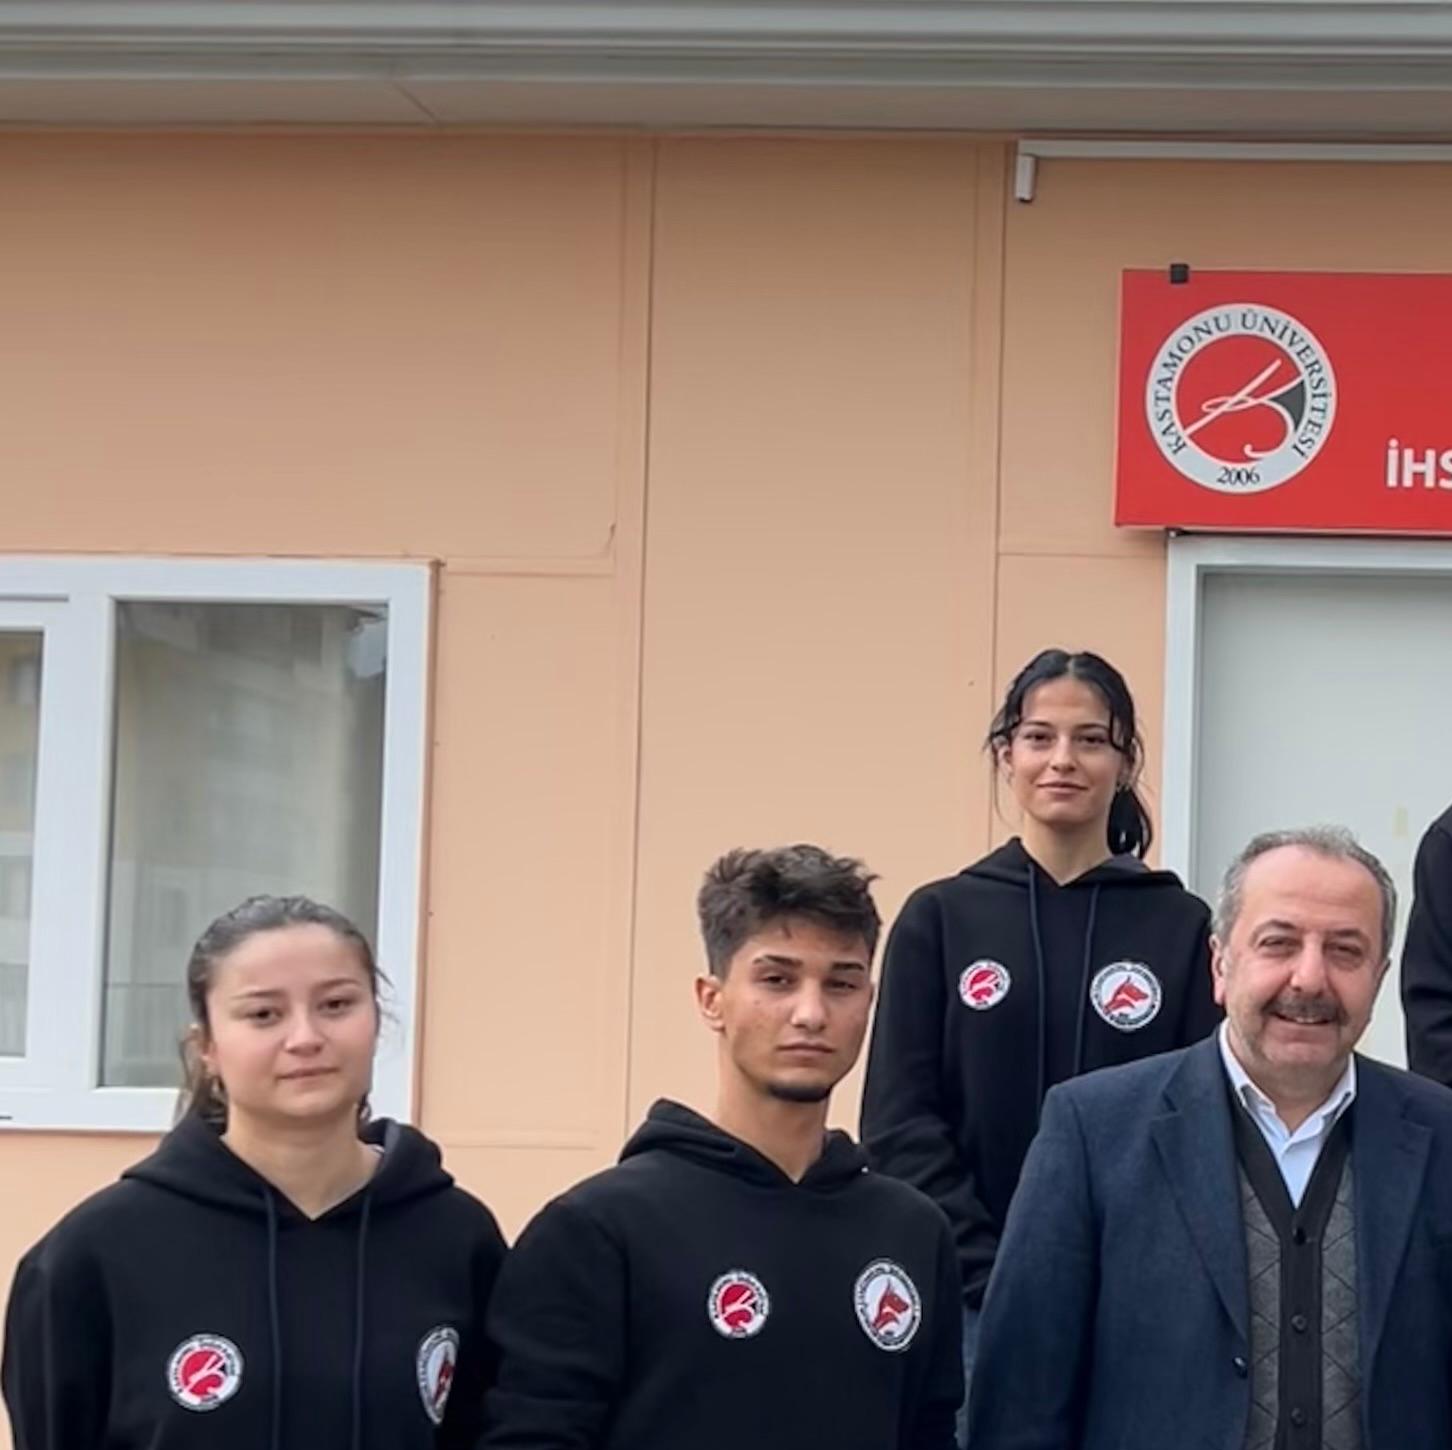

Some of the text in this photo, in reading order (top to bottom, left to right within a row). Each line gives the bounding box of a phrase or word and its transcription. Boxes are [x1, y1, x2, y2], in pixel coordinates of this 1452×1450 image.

[1154, 308, 1333, 460] KASTAMONU ÜNİVERSİTESİ
[1216, 466, 1261, 486] 2006
